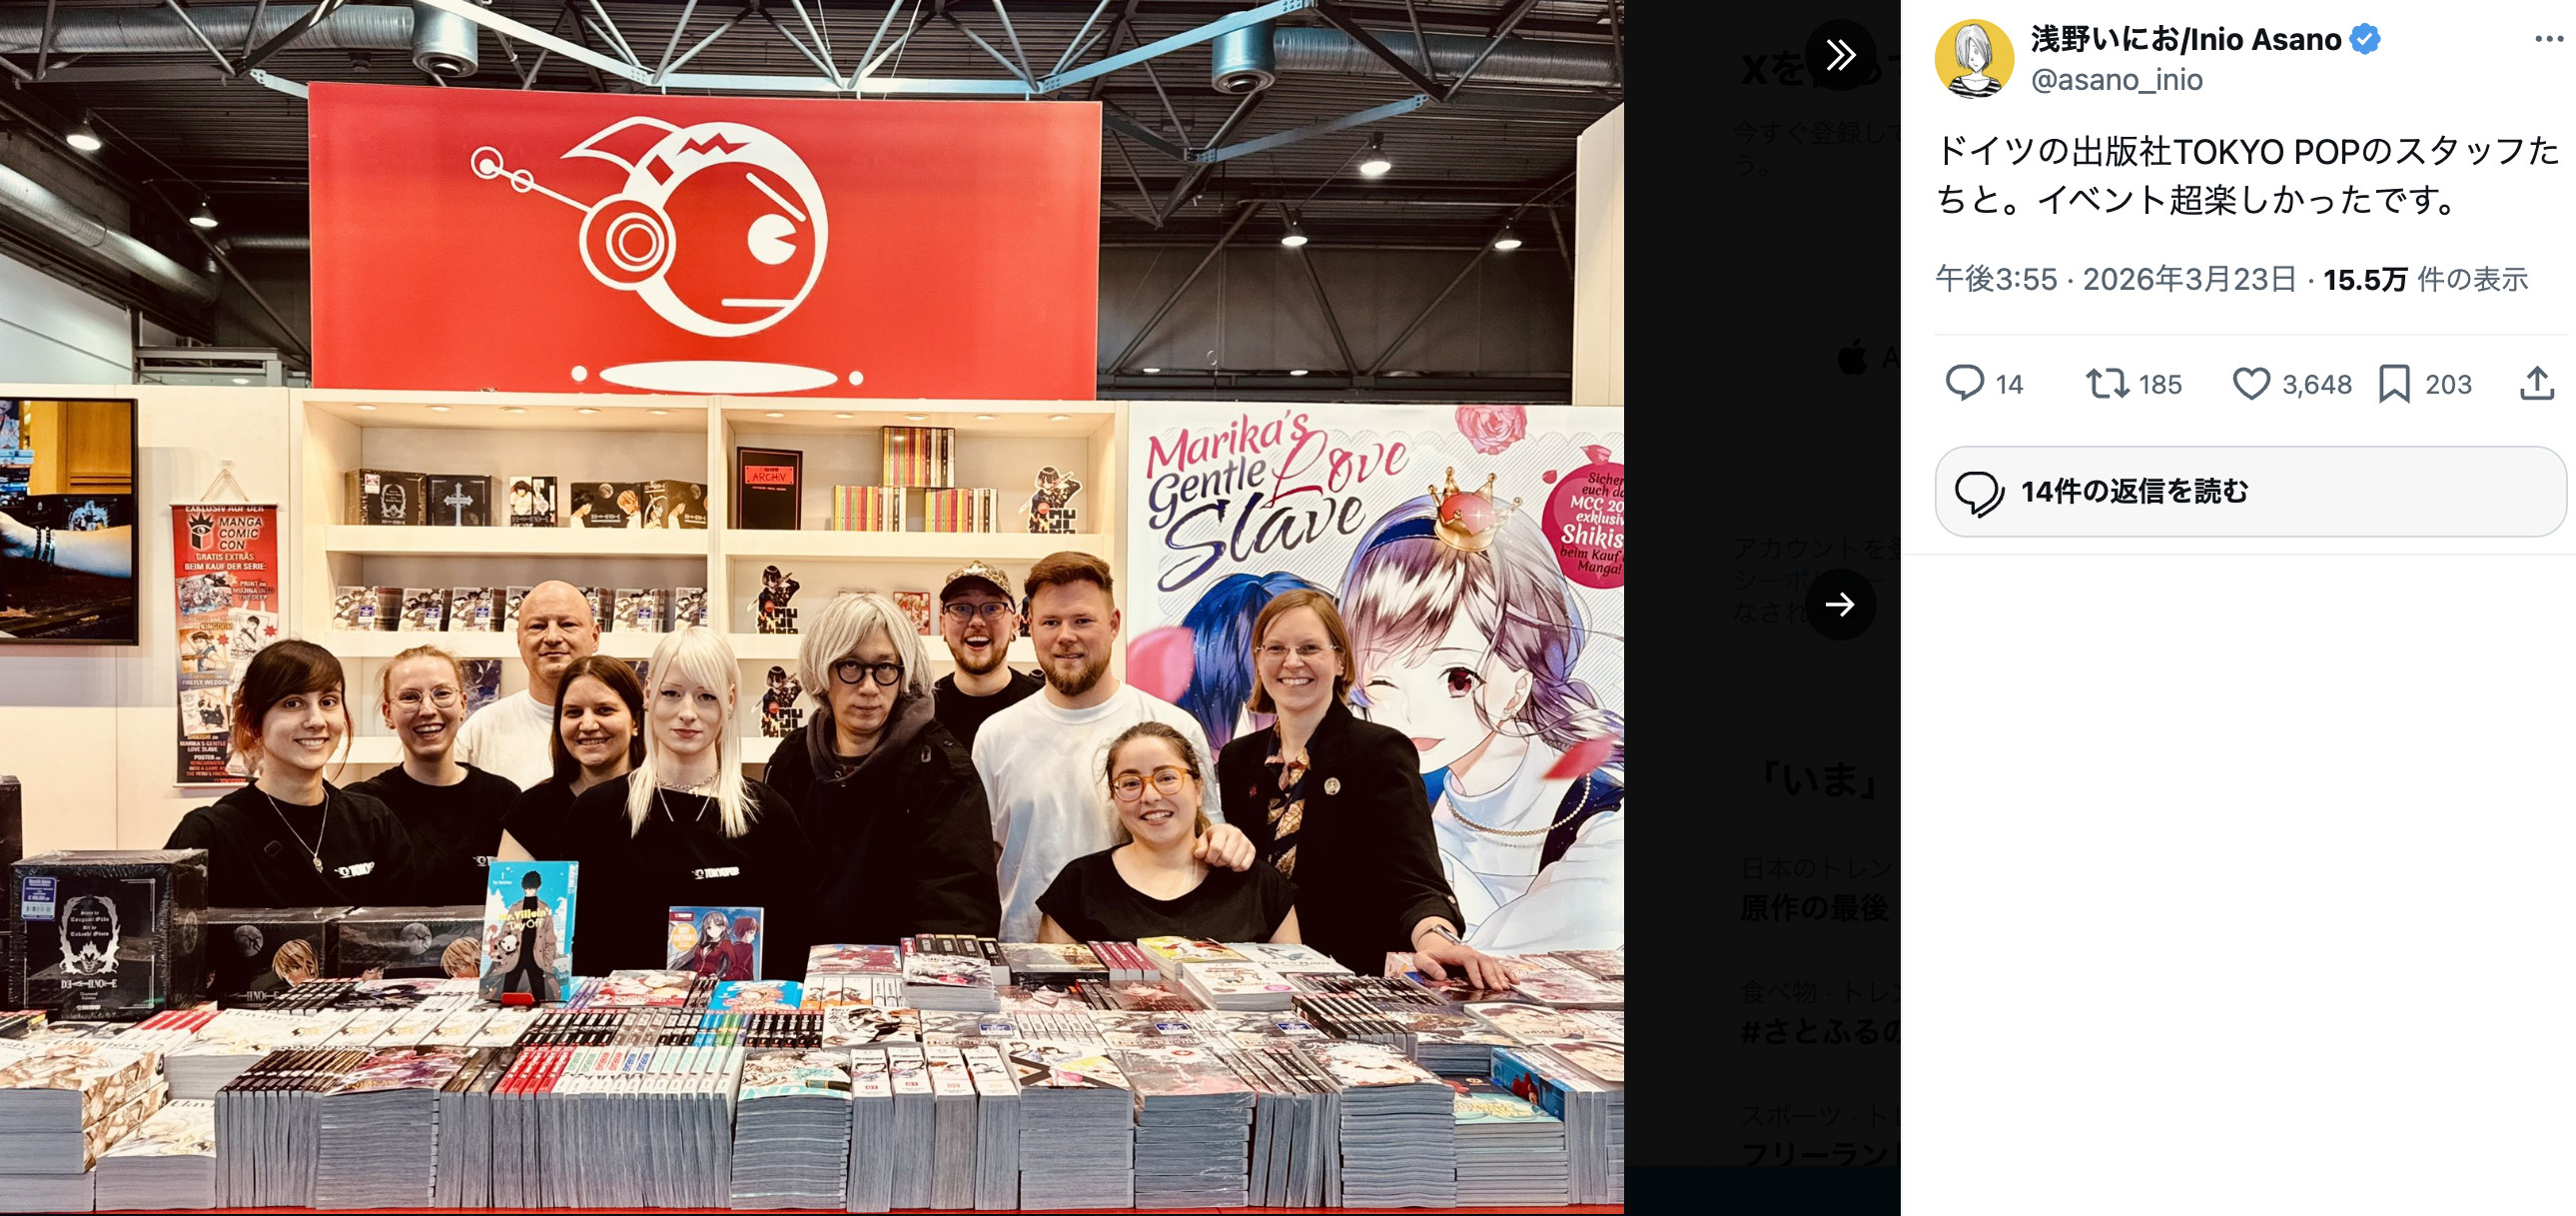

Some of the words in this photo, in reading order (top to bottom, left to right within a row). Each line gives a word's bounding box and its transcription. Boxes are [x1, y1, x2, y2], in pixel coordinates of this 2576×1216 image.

[1147, 410, 1310, 479] Marika's
[1261, 429, 1409, 510] Love
[752, 473, 787, 482] ARCHIV
[1149, 455, 1267, 530] Gentle
[1582, 486, 1609, 498] euch
[1570, 496, 1604, 511] MCC
[219, 517, 263, 527] MANGA
[219, 529, 259, 539] COMIC
[219, 541, 245, 551] CON
[1158, 493, 1367, 593] Slave
[1560, 545, 1587, 560] beim
[1591, 549, 1623, 564] Kauf
[1577, 561, 1623, 577] Manga!
[513, 906, 552, 919] Villain's
[506, 920, 525, 932] Day
[525, 917, 545, 929] Off
